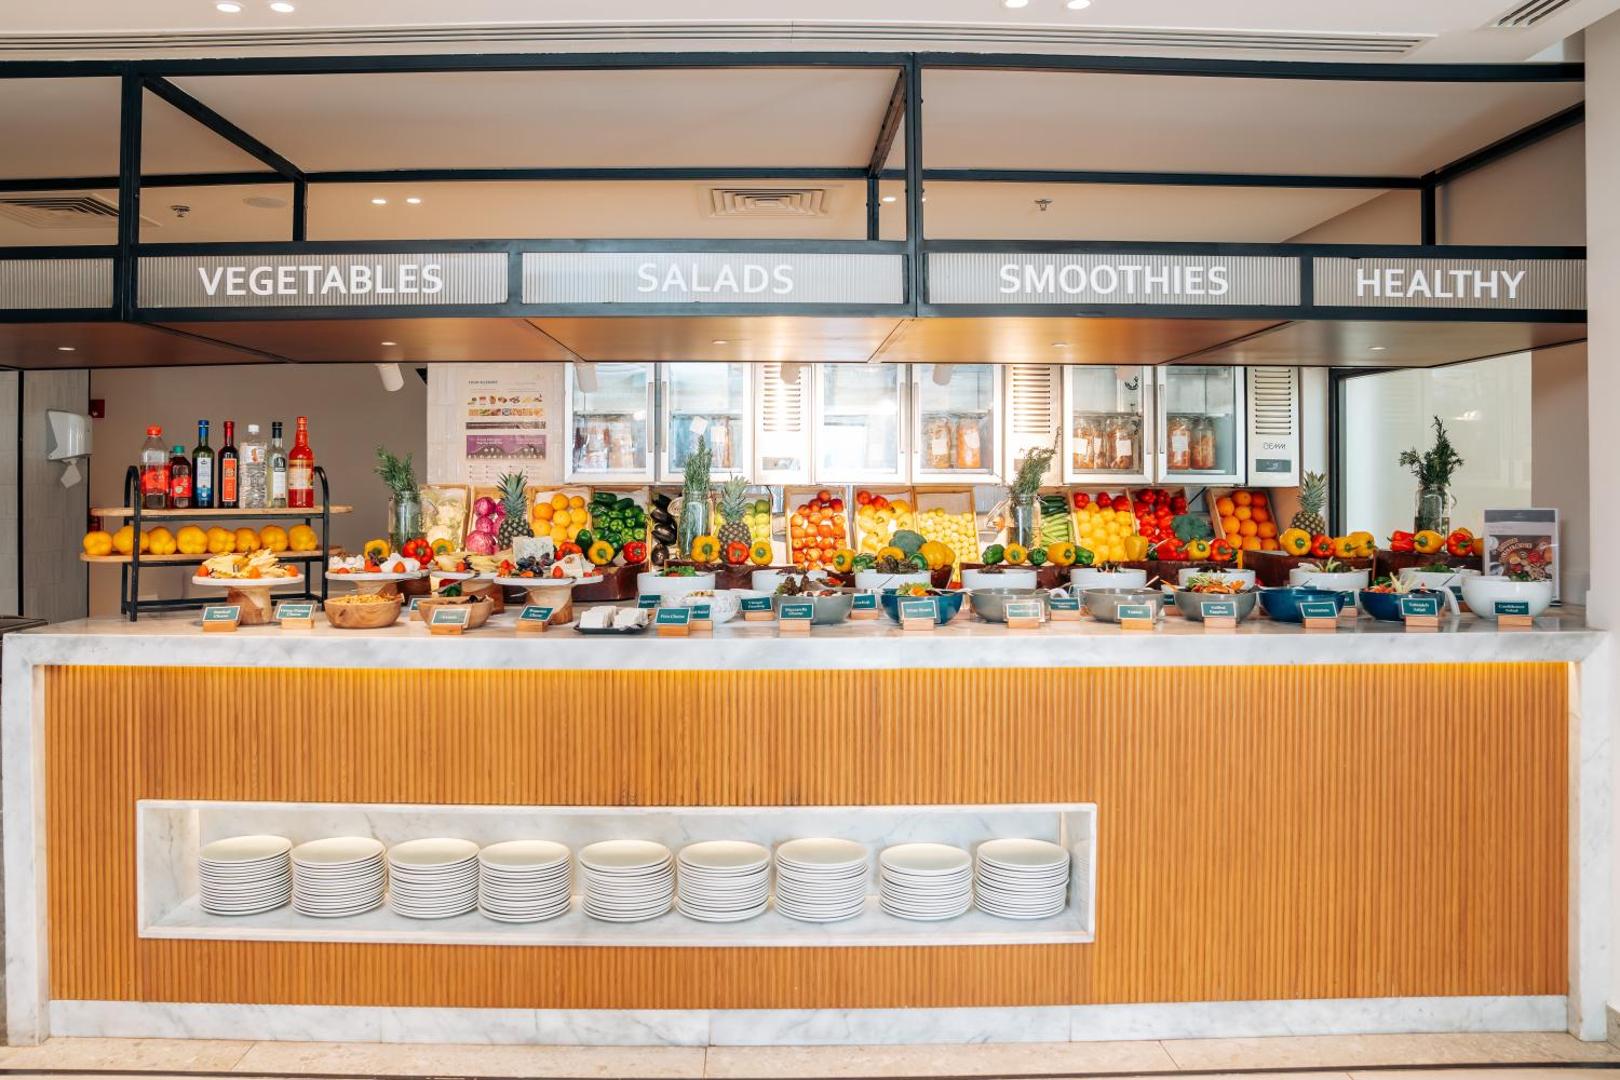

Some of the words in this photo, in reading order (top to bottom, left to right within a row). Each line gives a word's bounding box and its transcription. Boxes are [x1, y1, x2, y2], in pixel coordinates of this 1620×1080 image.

[198, 264, 443, 296] VEGETABLES
[637, 262, 794, 294] SALADS
[999, 264, 1229, 295] SMOOTHIES
[1356, 268, 1527, 299] HEALTHY
